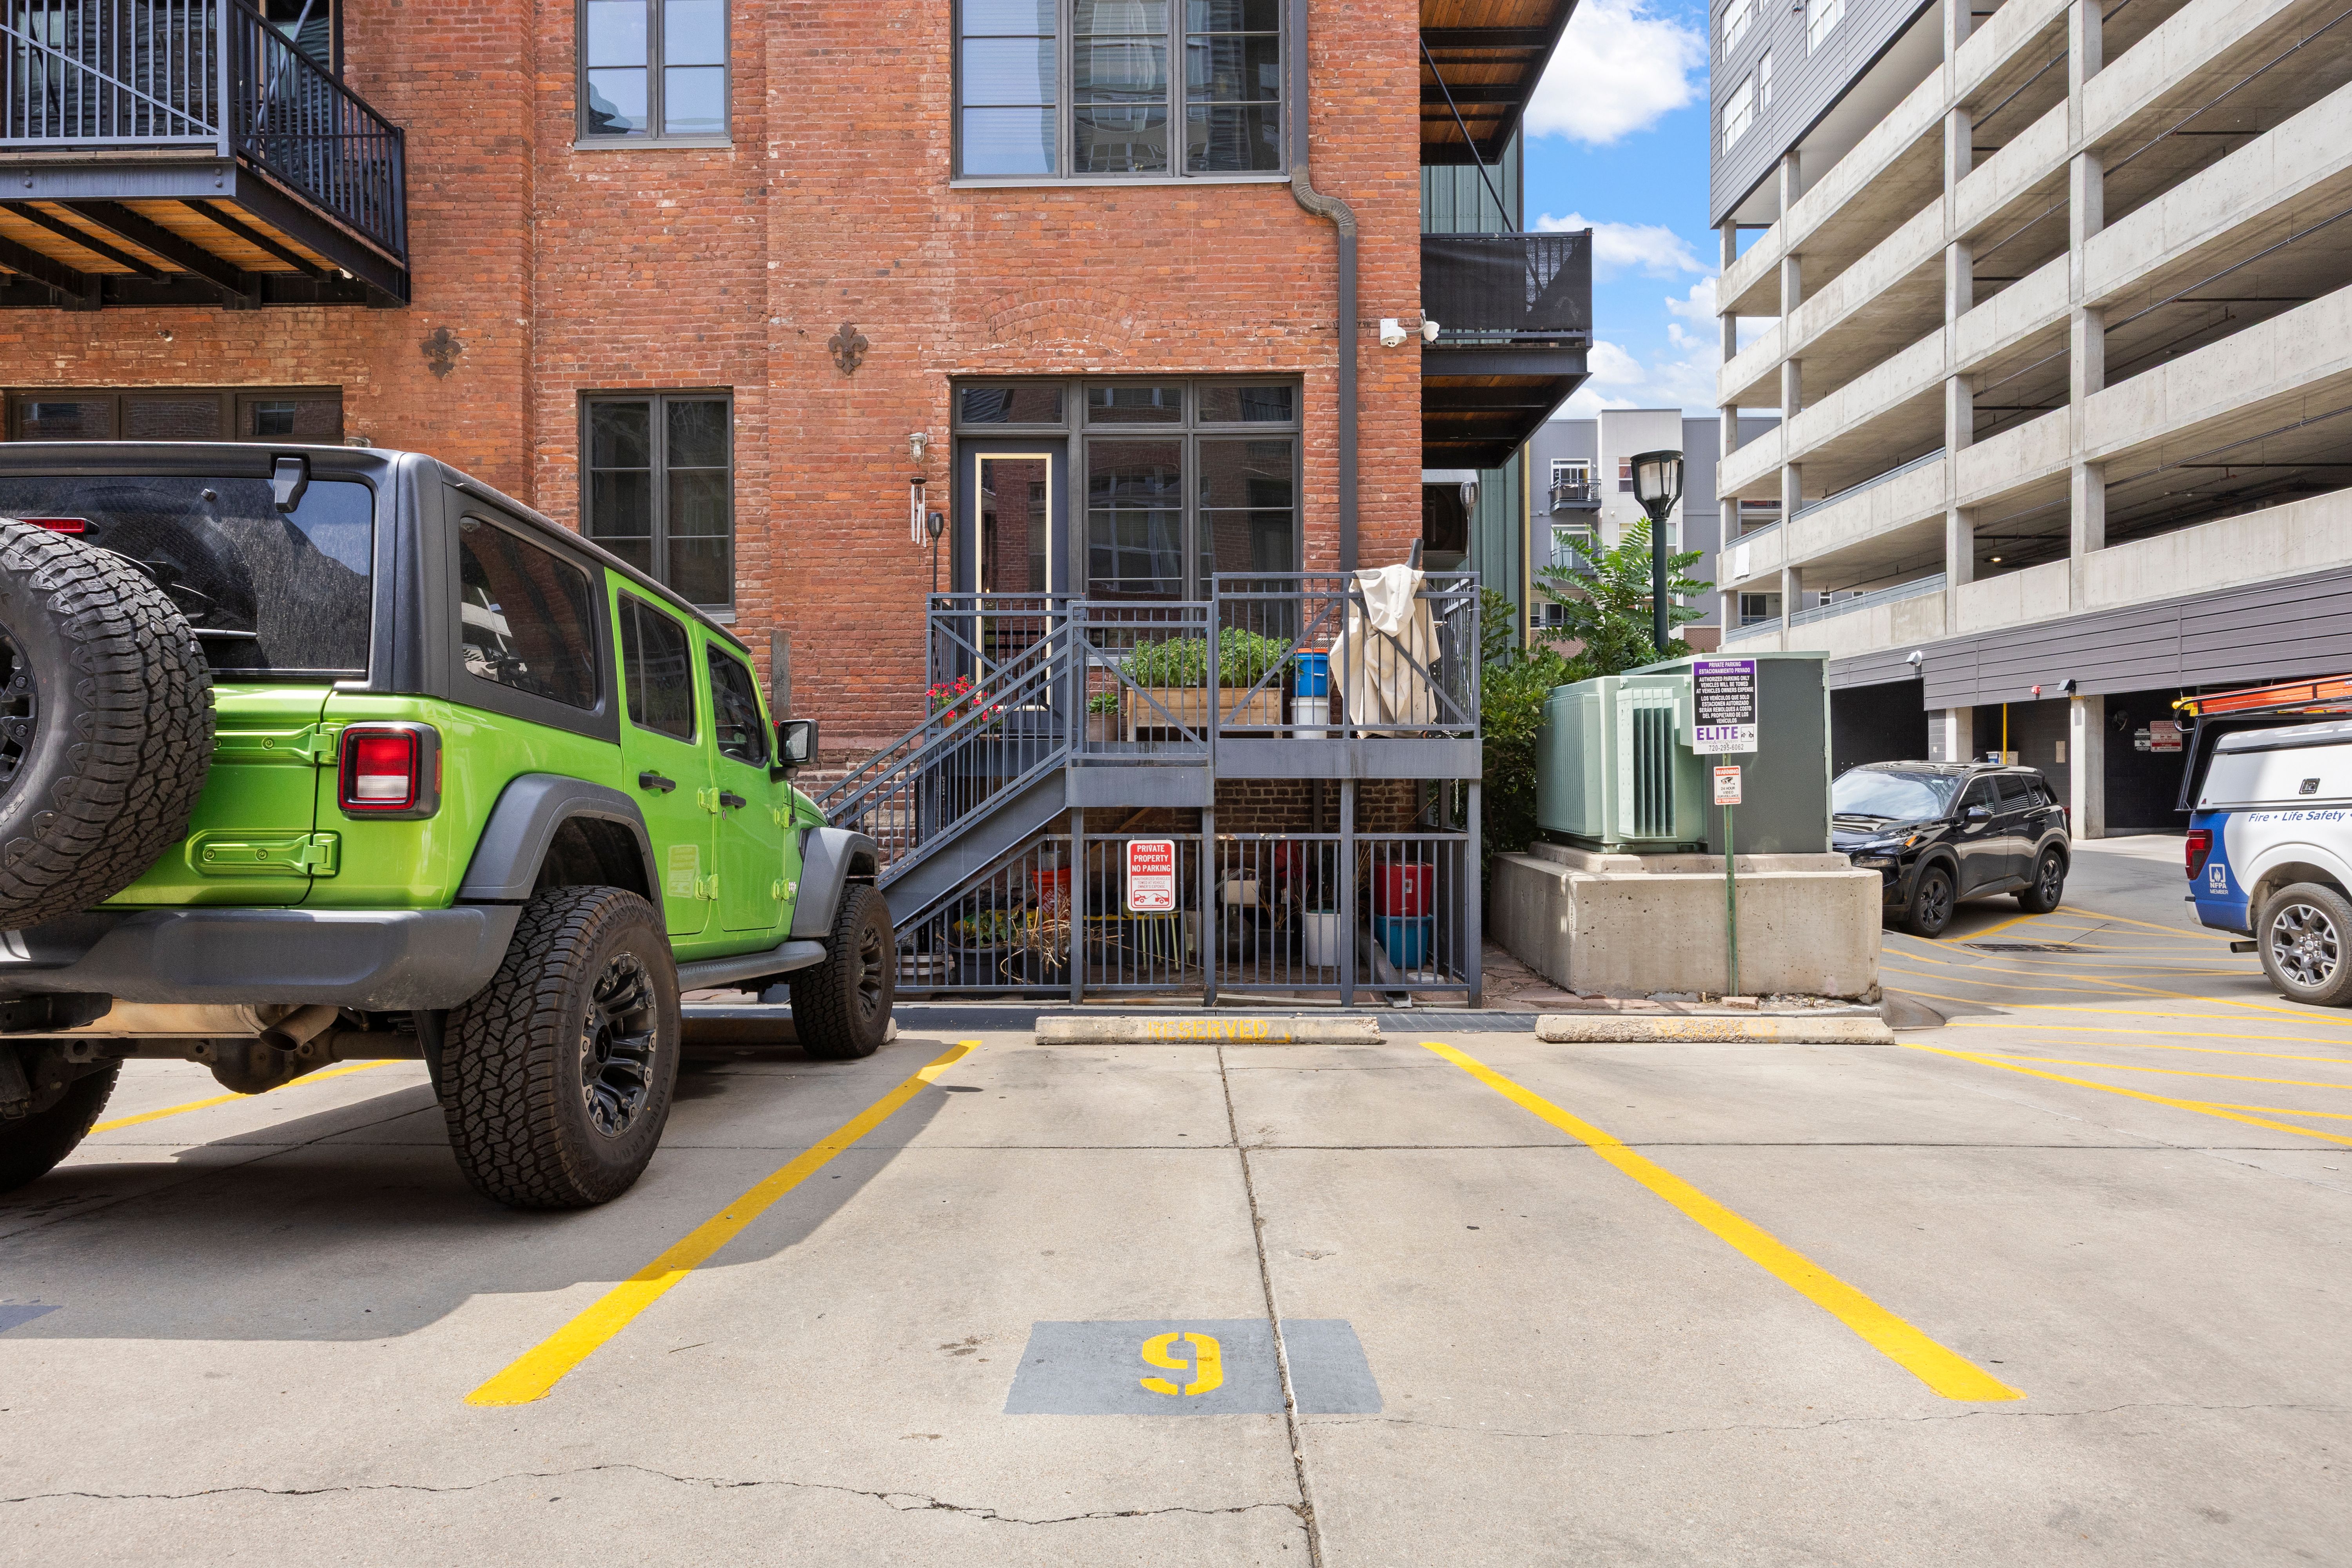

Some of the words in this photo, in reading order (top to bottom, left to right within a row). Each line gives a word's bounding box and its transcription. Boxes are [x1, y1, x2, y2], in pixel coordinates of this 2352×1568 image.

[1697, 726, 1738, 740] ELITE
[2249, 813, 2269, 822] Fire
[2282, 812, 2303, 821] Life
[2306, 811, 2346, 822] Safety
[1148, 1020, 1268, 1040] RESERVED
[1140, 1332, 1223, 1396] 9
